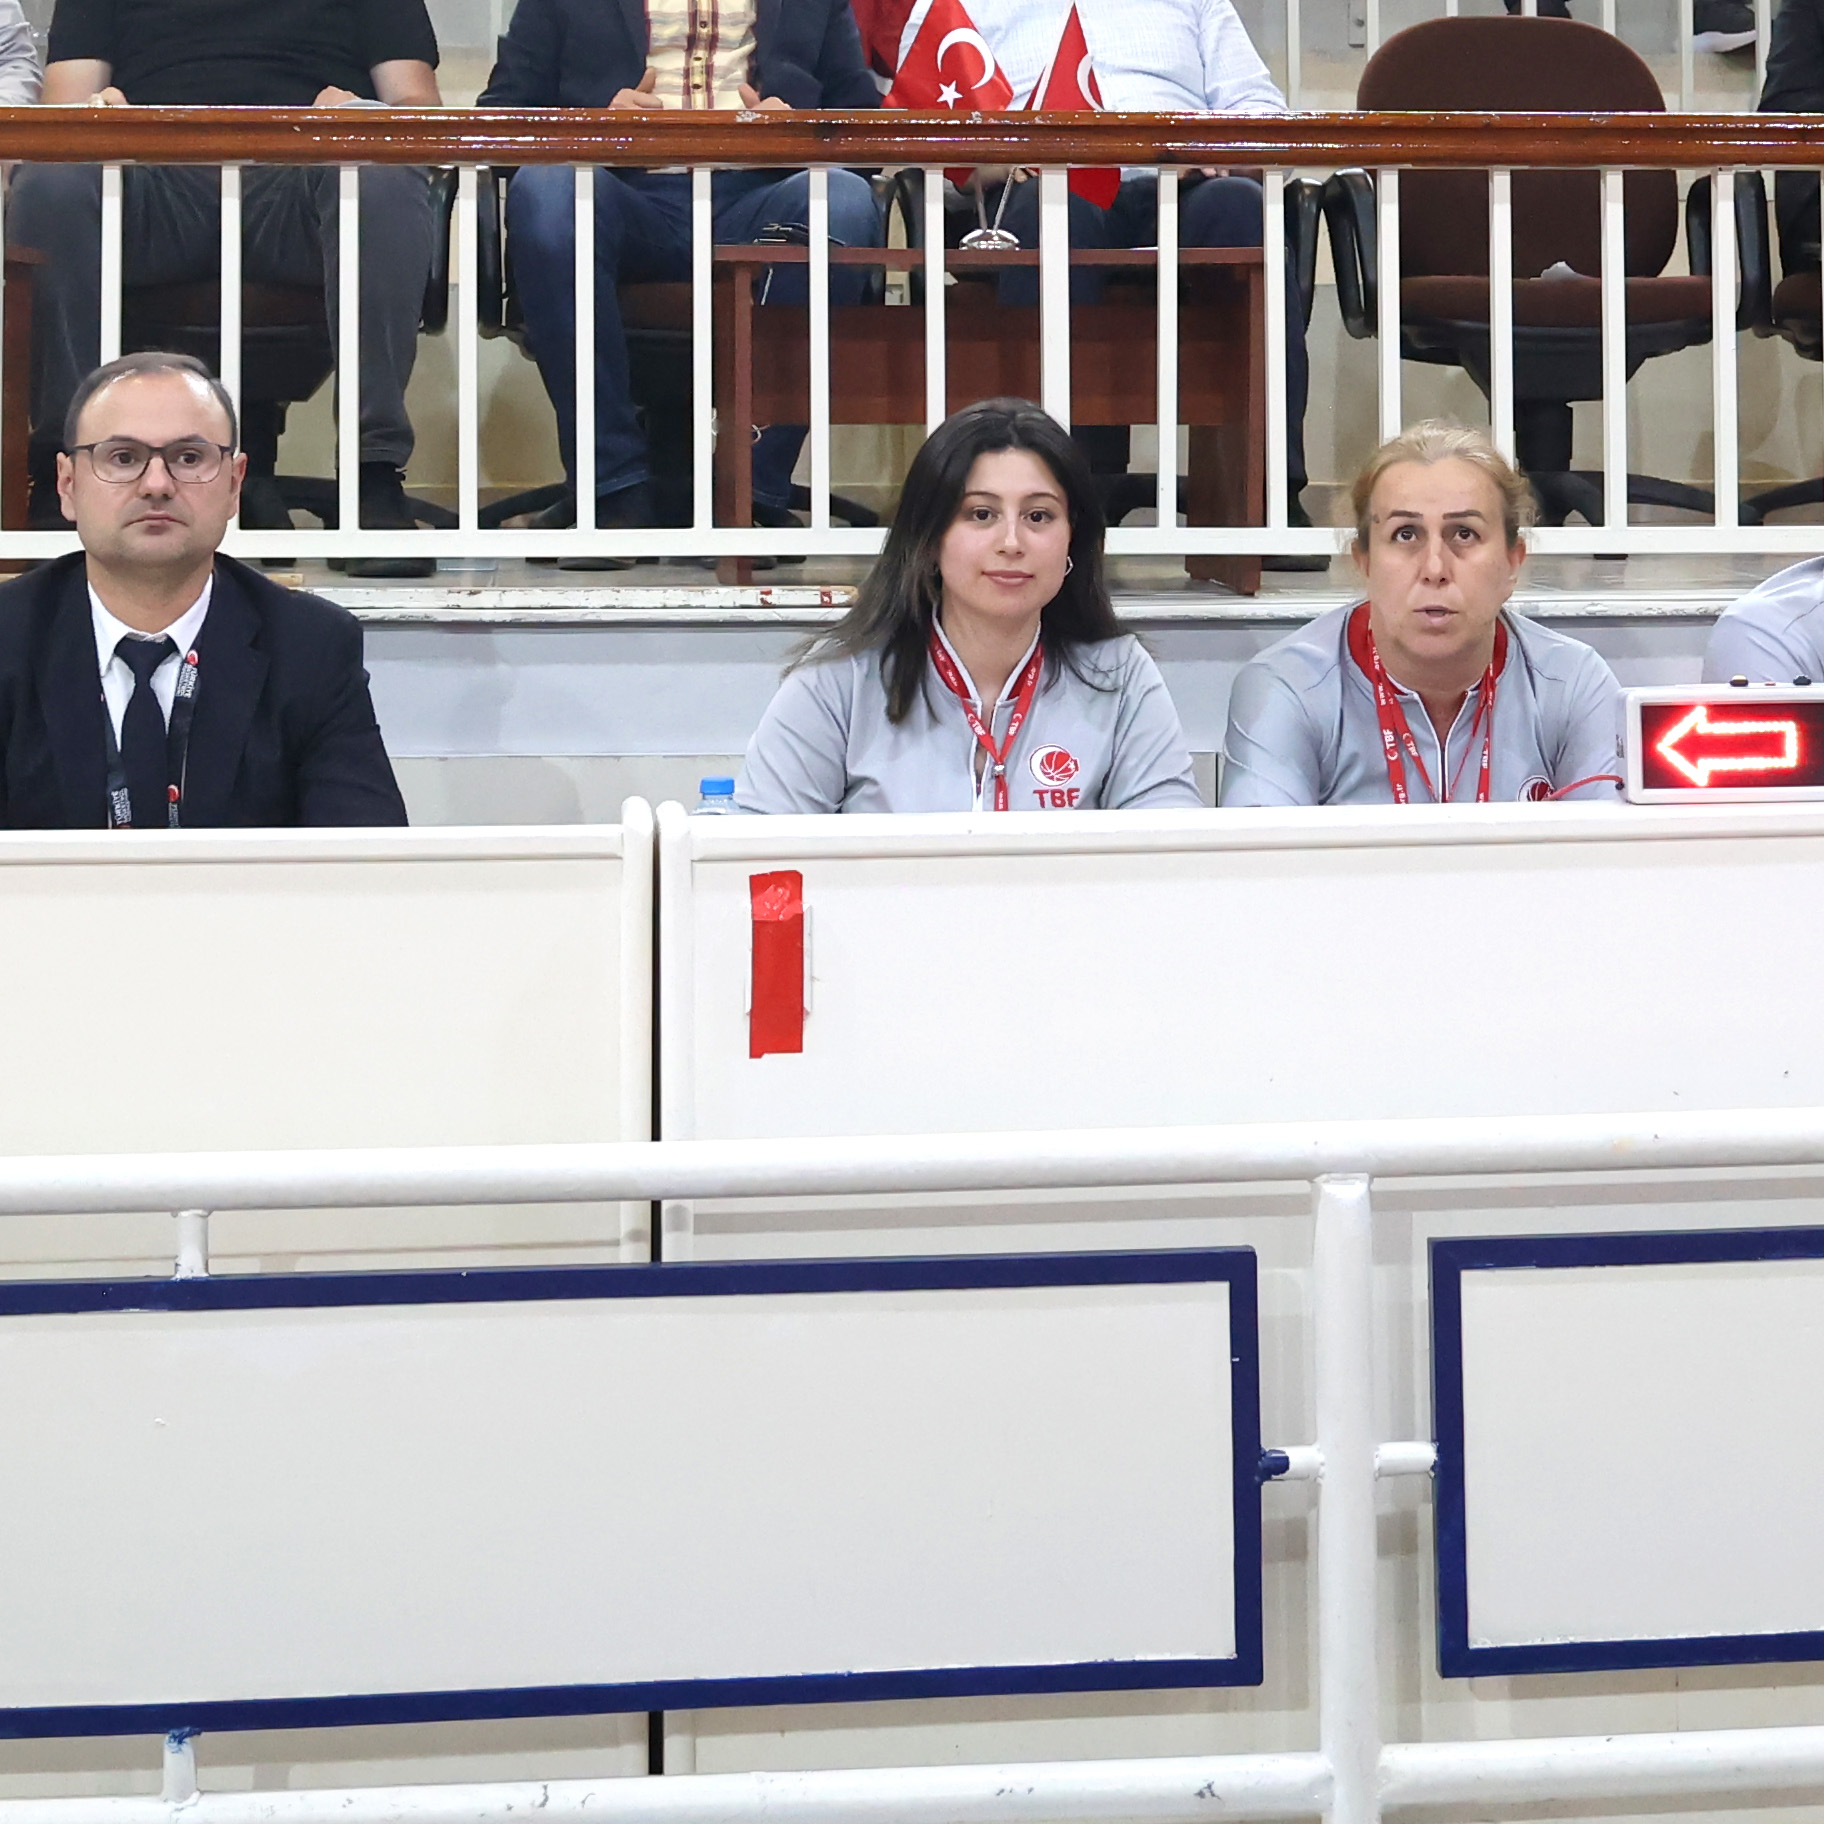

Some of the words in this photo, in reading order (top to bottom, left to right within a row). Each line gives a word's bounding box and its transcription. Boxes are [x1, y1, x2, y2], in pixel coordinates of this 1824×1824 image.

[972, 720, 986, 736] TBF
[1383, 729, 1396, 749] TBF
[1033, 788, 1081, 808] TBF
